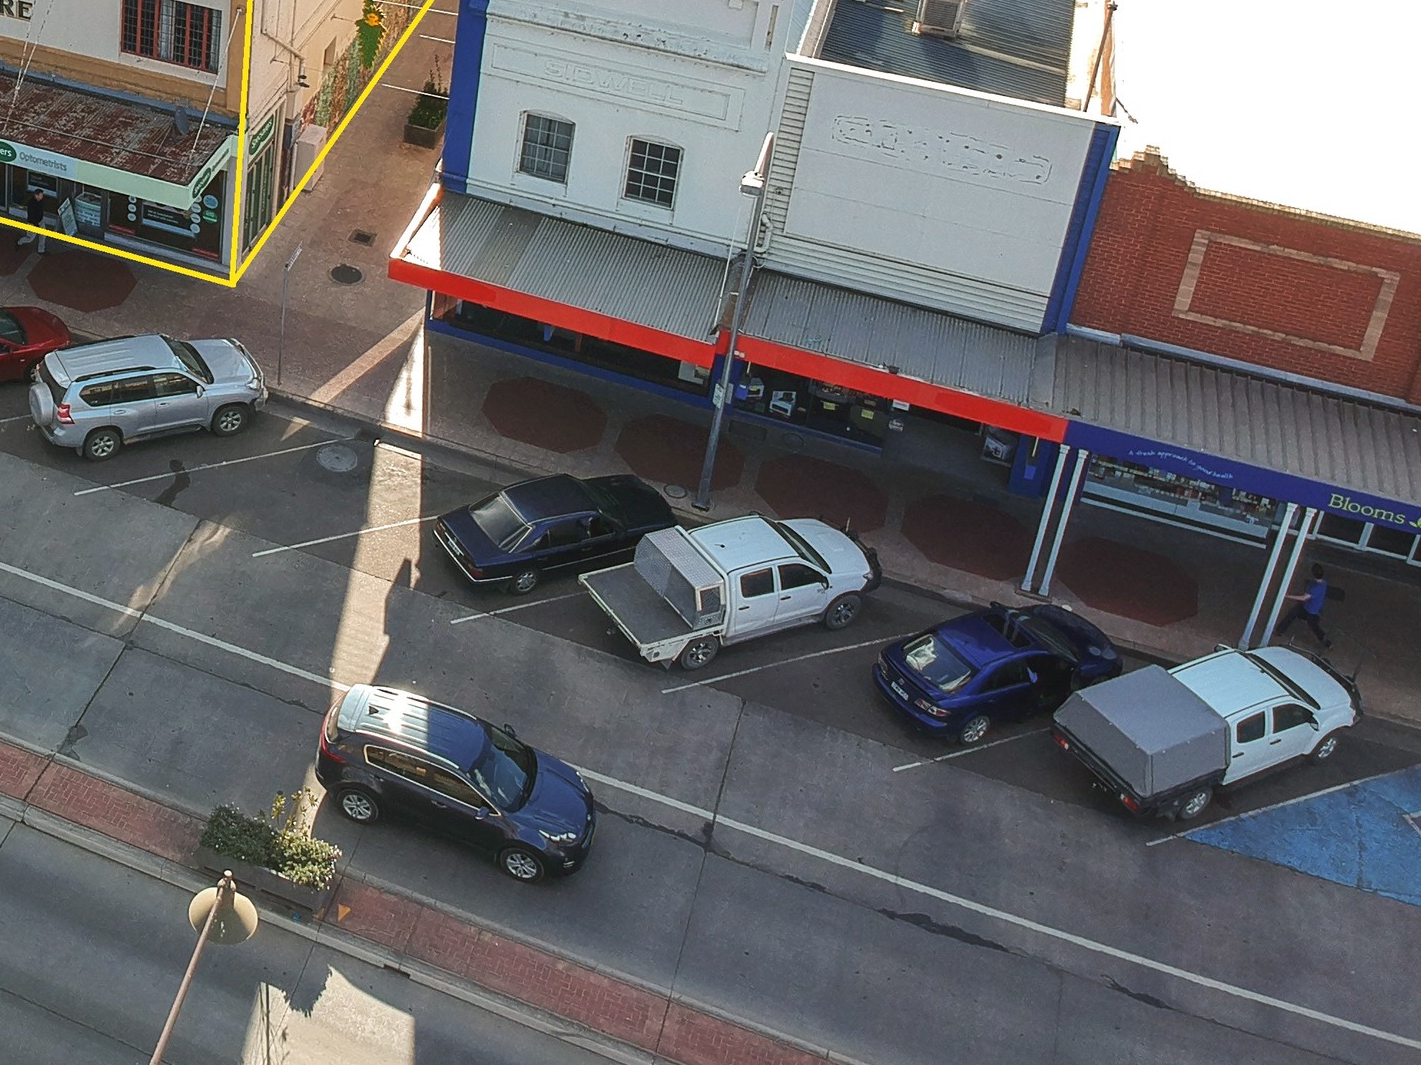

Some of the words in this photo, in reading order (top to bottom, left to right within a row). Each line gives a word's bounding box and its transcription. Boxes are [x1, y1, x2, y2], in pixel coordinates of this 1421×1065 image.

[543, 58, 684, 105] SIDWELL
[19, 151, 68, 172] Optometrists
[1328, 493, 1406, 525] Blooms
